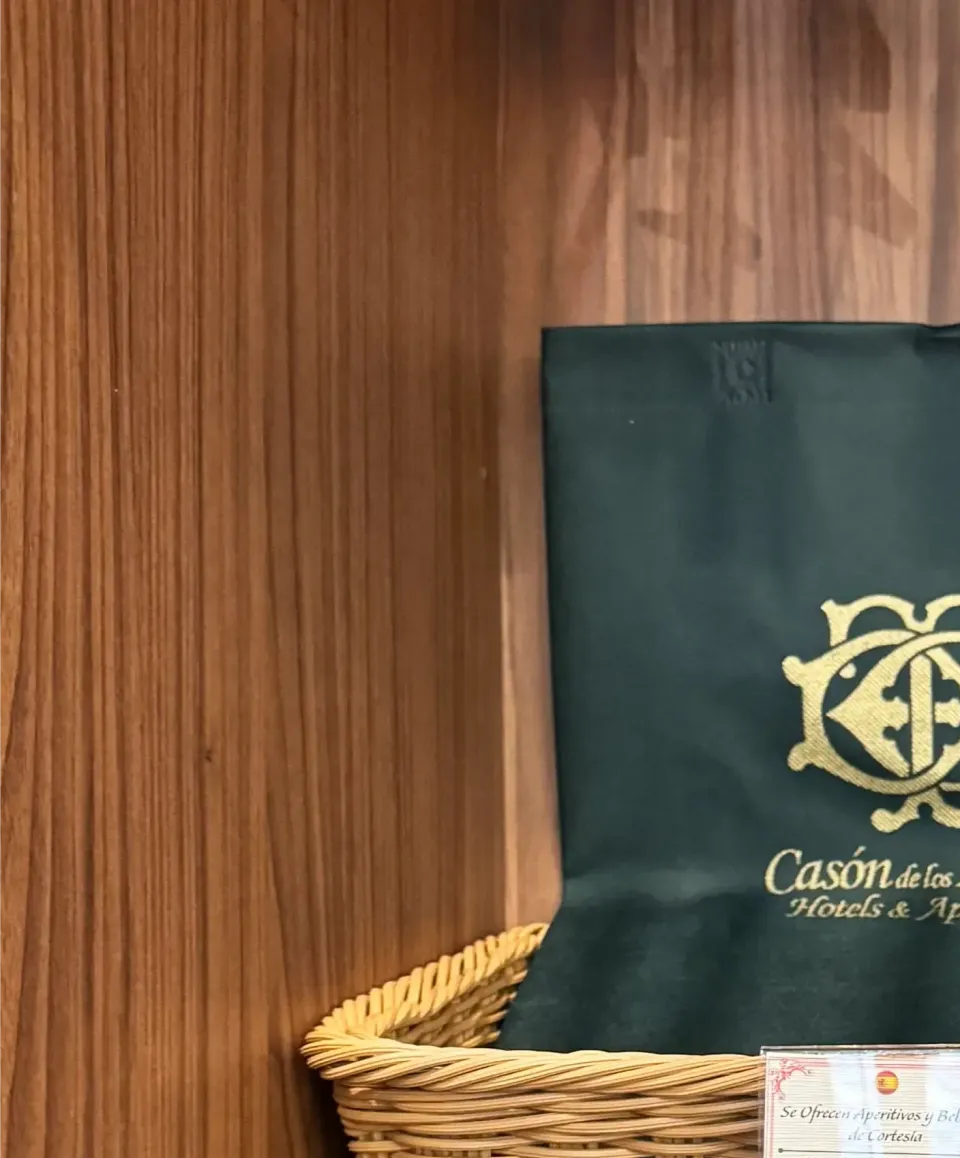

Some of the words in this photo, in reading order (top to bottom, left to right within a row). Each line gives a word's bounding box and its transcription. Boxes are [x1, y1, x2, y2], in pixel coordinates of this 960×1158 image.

[764, 846, 893, 895] Casón
[895, 863, 921, 890] de
[922, 863, 953, 889] los
[786, 893, 885, 919] Hotels
[887, 901, 911, 918] &
[780, 1106, 797, 1118] Se
[800, 1103, 850, 1124] Ofrecen
[853, 1107, 921, 1125] Aperitivos
[920, 1112, 934, 1127] y
